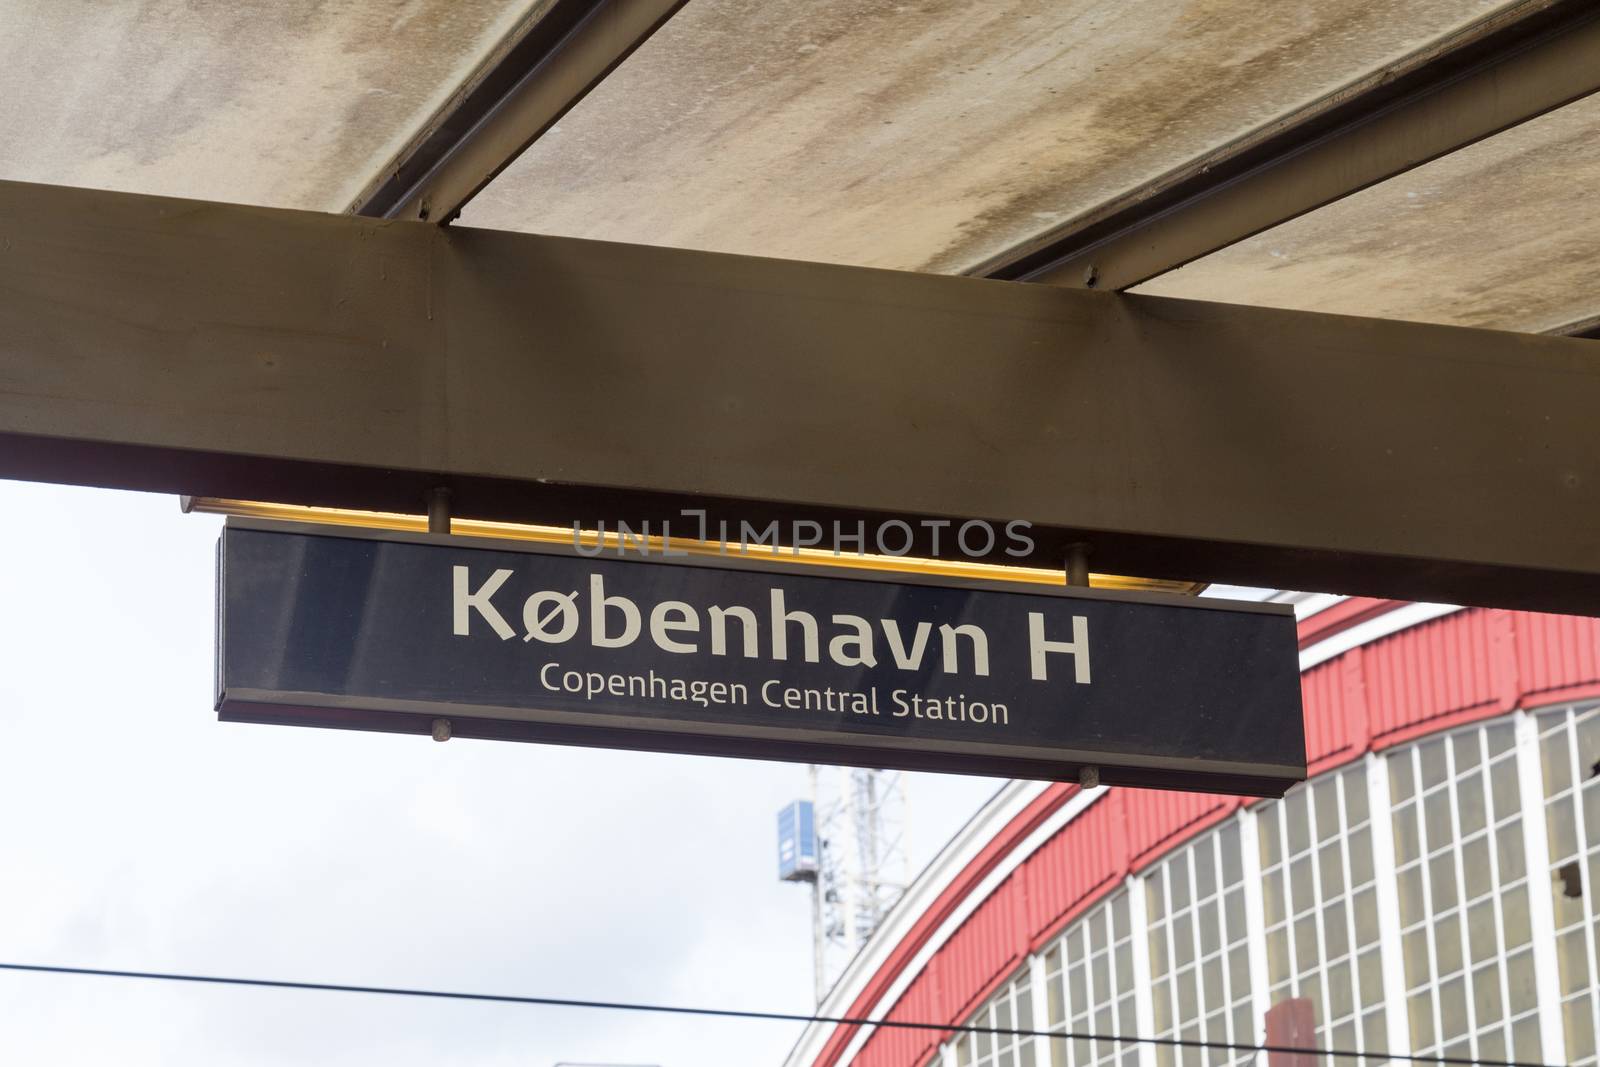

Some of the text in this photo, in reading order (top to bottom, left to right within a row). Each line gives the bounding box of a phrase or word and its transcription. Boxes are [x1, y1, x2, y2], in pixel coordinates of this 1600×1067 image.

[452, 565, 1092, 686] København H
[539, 662, 1010, 727] Copenhagen Central Station
